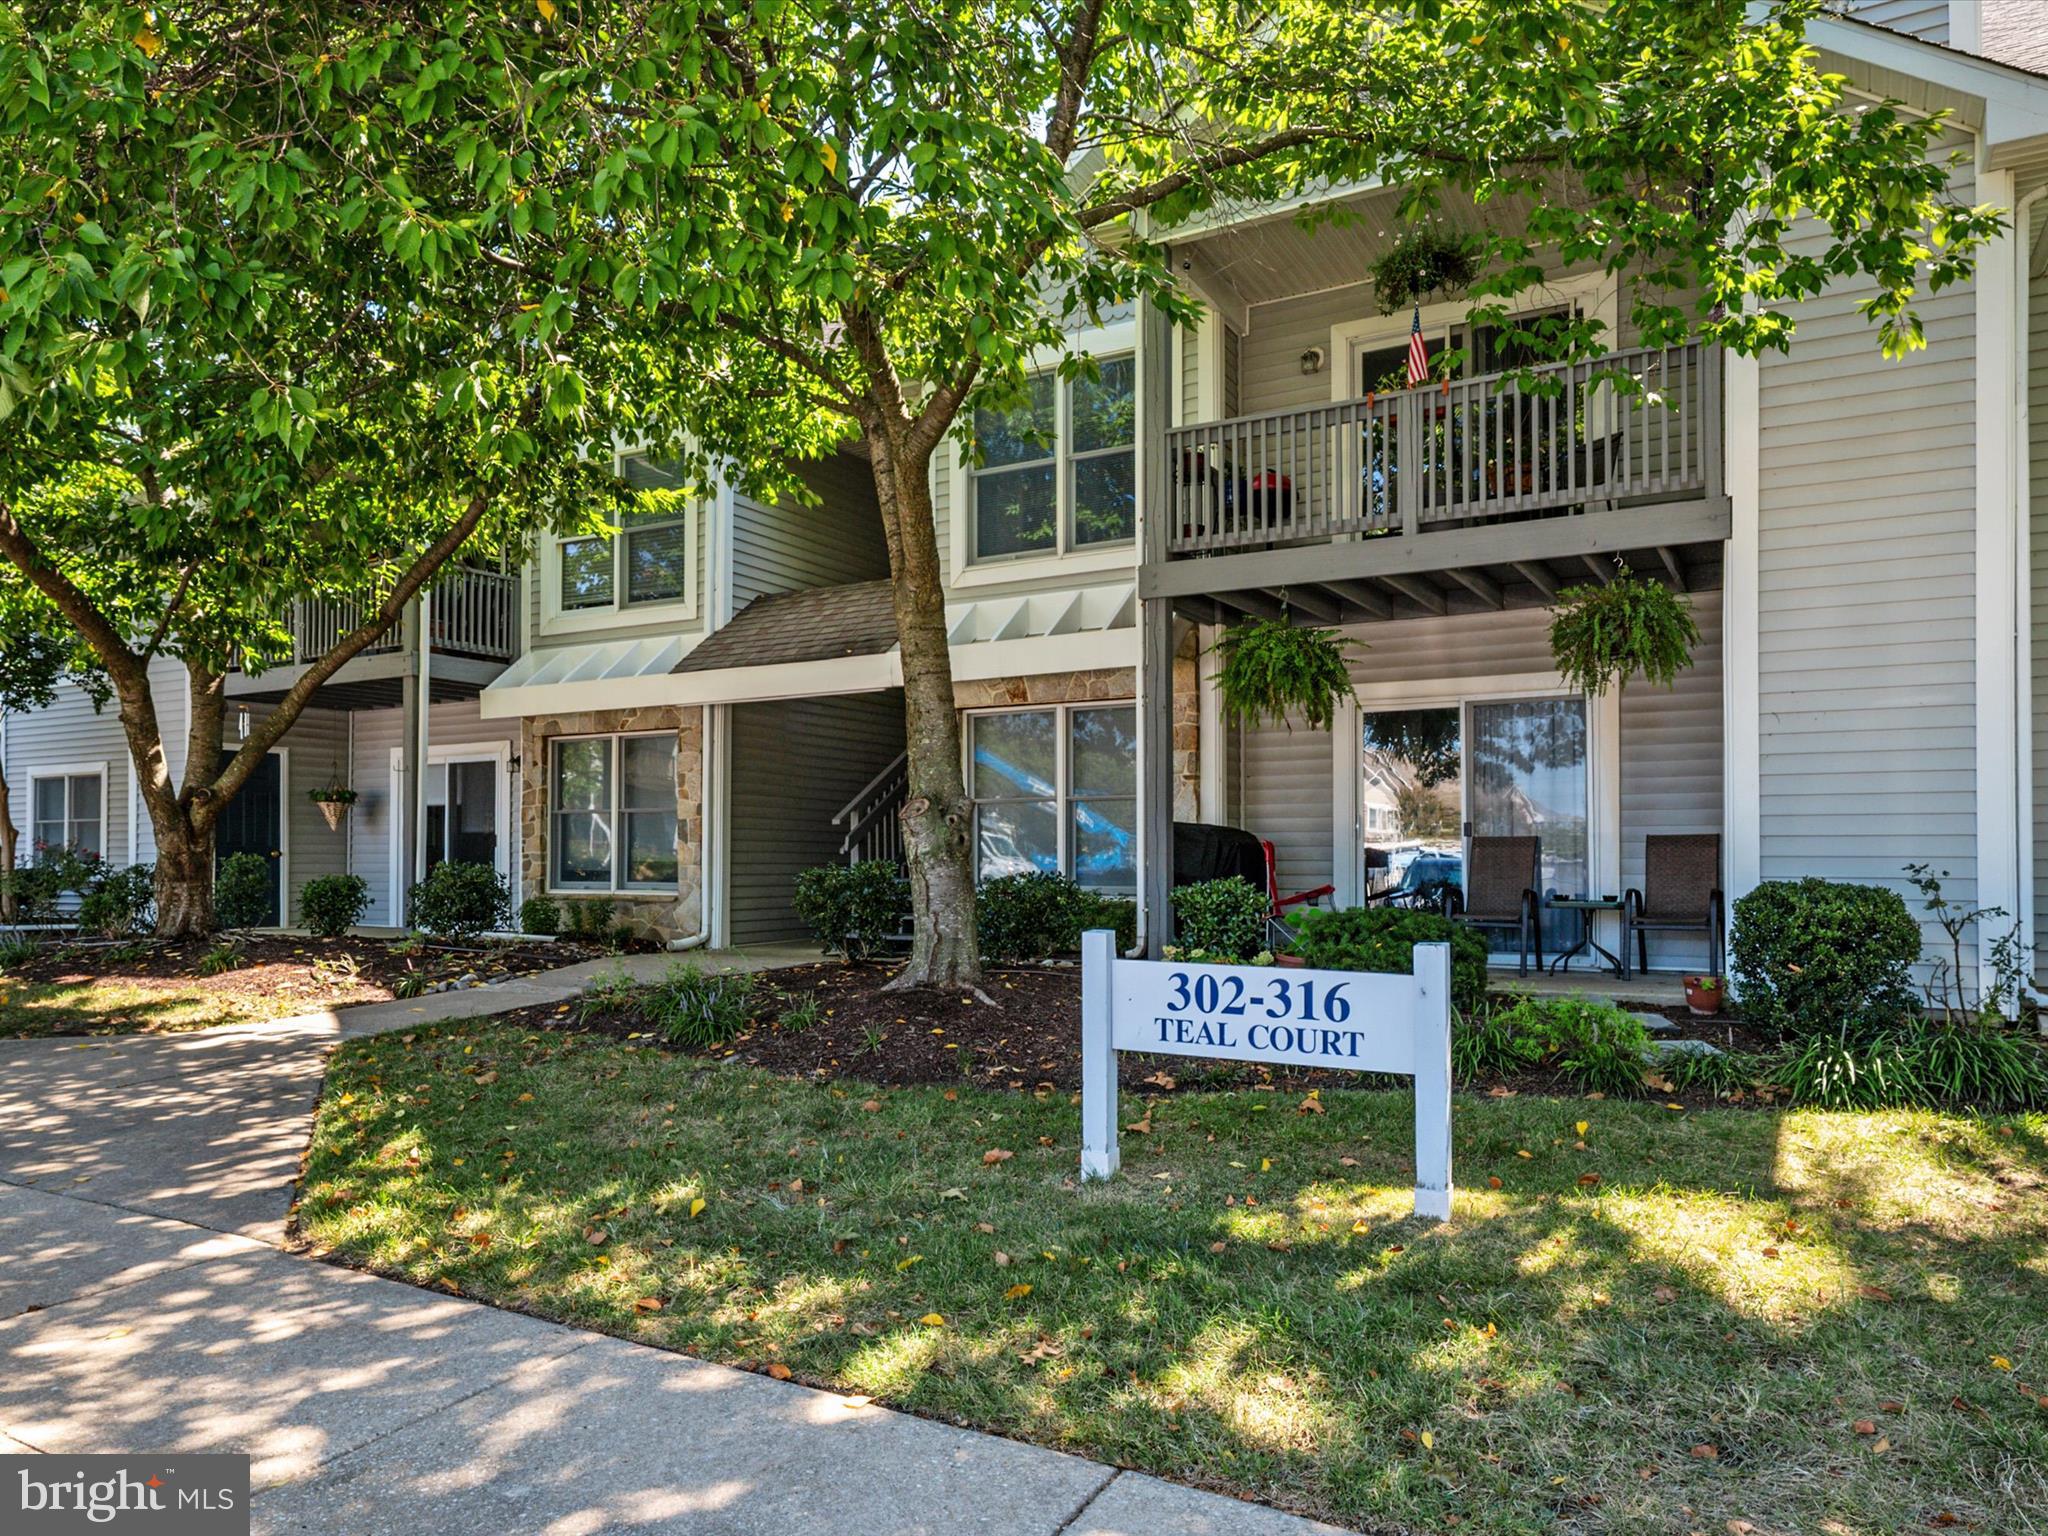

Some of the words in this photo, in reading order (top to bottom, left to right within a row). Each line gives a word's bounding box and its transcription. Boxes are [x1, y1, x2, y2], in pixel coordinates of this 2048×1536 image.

[1166, 973, 1351, 1023] 302-316
[1154, 1017, 1237, 1048] TEAL
[1247, 1024, 1365, 1058] COURT
